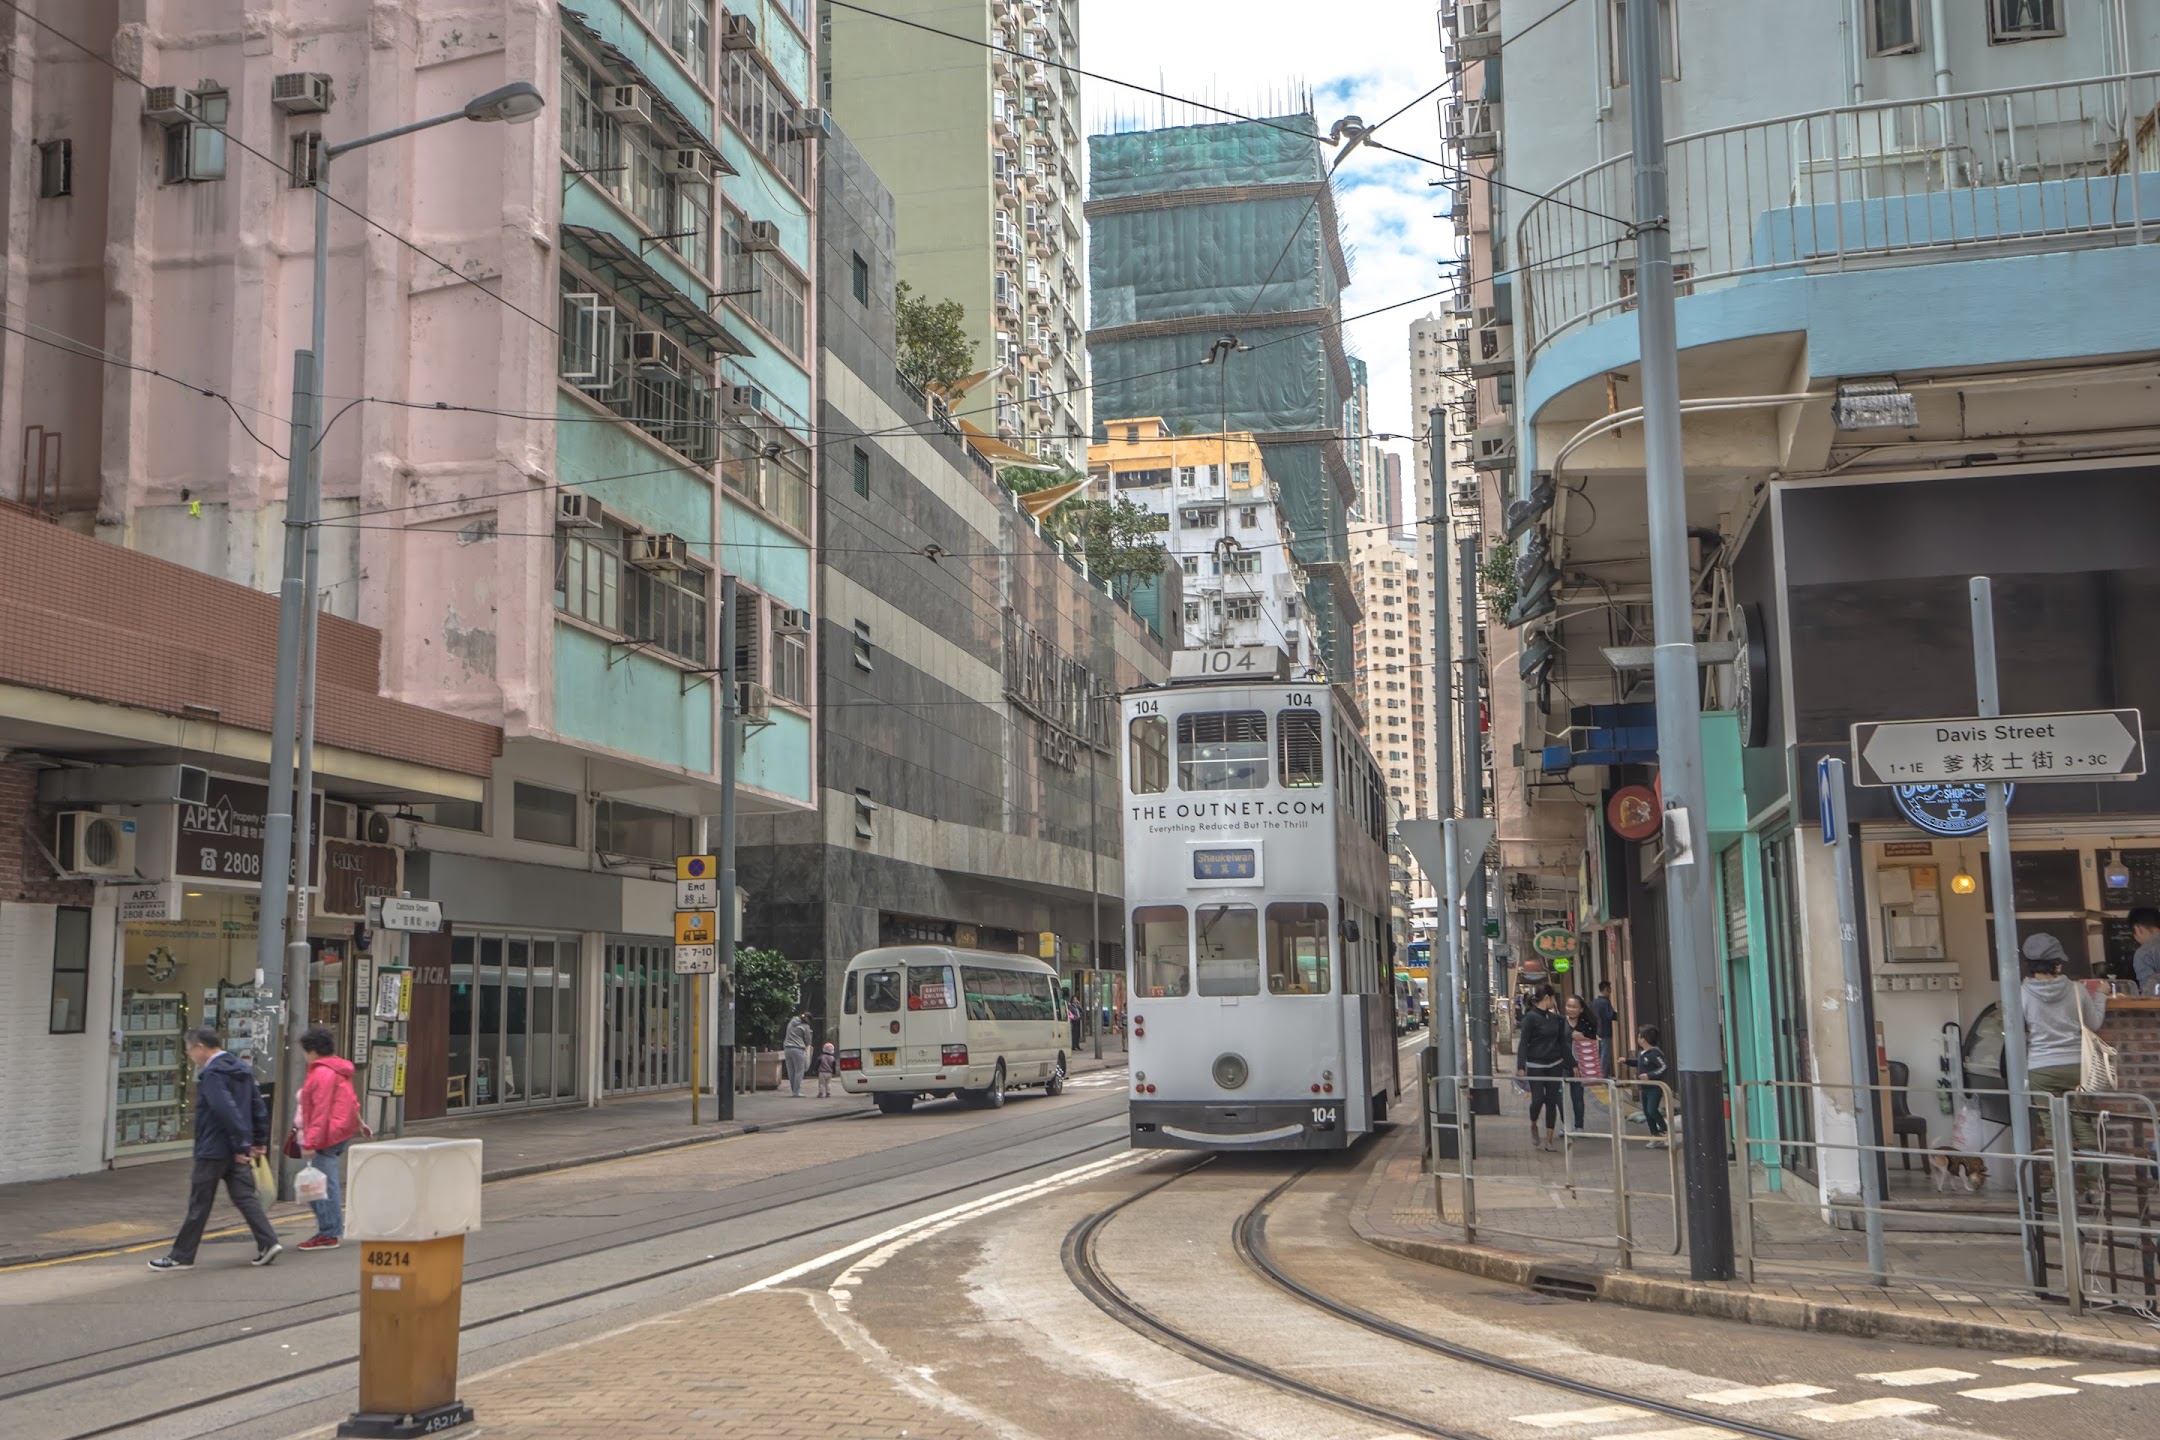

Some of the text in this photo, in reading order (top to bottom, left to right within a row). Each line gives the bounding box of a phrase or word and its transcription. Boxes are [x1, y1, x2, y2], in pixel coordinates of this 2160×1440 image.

[1201, 650, 1256, 674] 104
[1135, 700, 1159, 714] 104
[1285, 693, 1313, 707] 104
[1936, 724, 2055, 743] Davis Street
[1944, 789, 1966, 800] SHOP
[1132, 801, 1325, 820] THE OUTNET.COM
[183, 804, 229, 833] APEX
[233, 811, 259, 825] Property
[1149, 820, 1308, 834] Everything Reduced But The Thrill
[223, 851, 260, 875] 2808
[1198, 852, 1255, 863] Shaukeiwan
[688, 882, 706, 891] End
[132, 890, 157, 900] APEX
[684, 894, 709, 905] 終止
[123, 910, 144, 919] 2808
[415, 903, 429, 912] Street
[691, 947, 712, 957] 7-10
[690, 961, 709, 971] 4-7
[411, 966, 449, 985] ATCH.
[1312, 1107, 1336, 1123] 104
[367, 1251, 410, 1267] 48214
[425, 1412, 463, 1433] 48214
